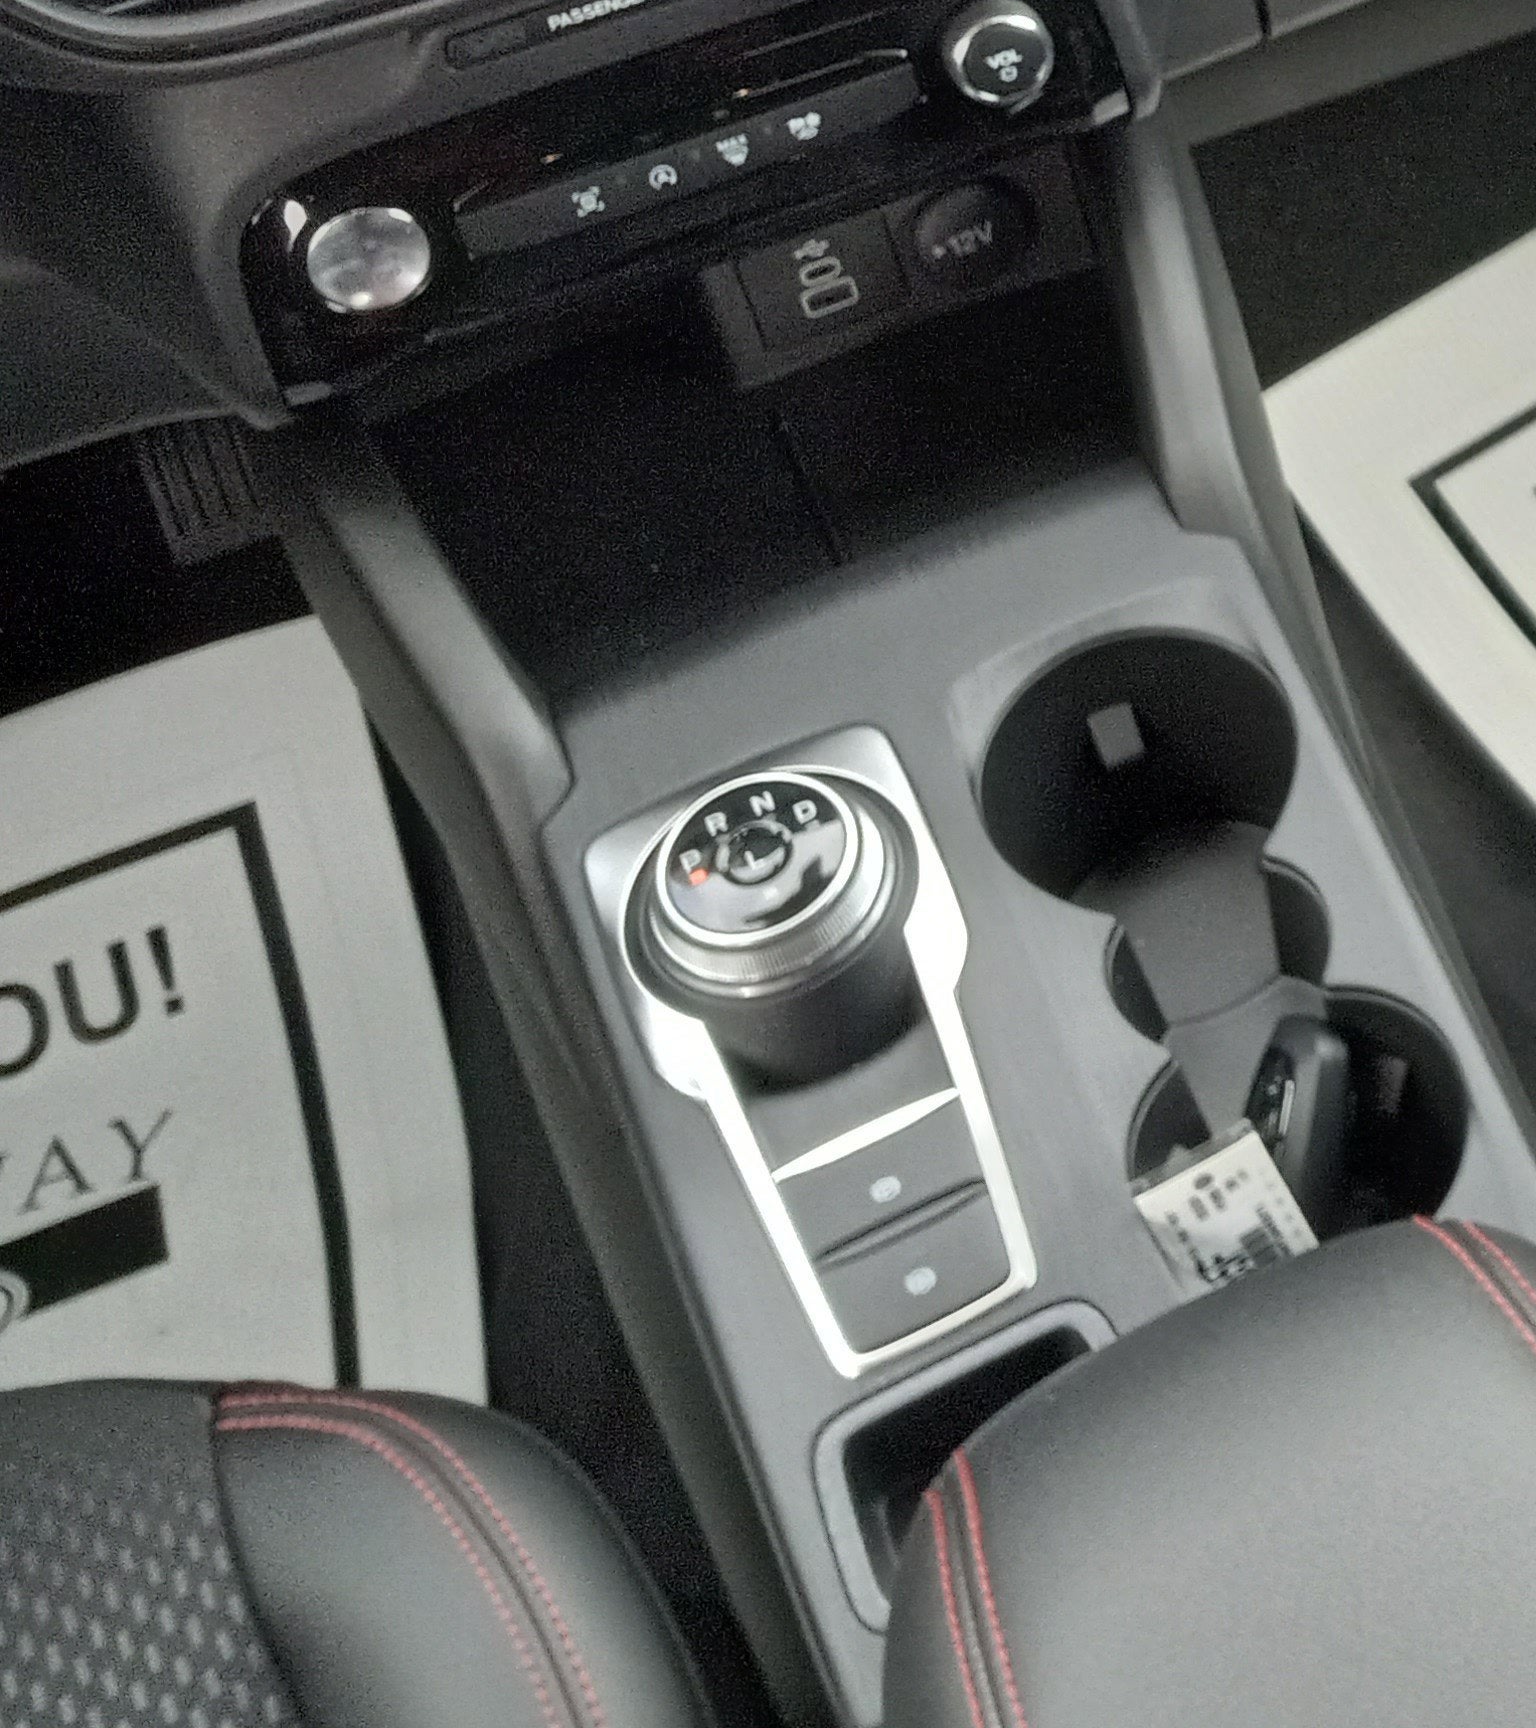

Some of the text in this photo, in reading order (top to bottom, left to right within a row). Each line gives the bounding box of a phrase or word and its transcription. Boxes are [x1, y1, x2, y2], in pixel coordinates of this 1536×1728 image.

[749, 790, 776, 817] N
[792, 799, 818, 824] D
[704, 811, 729, 837] R
